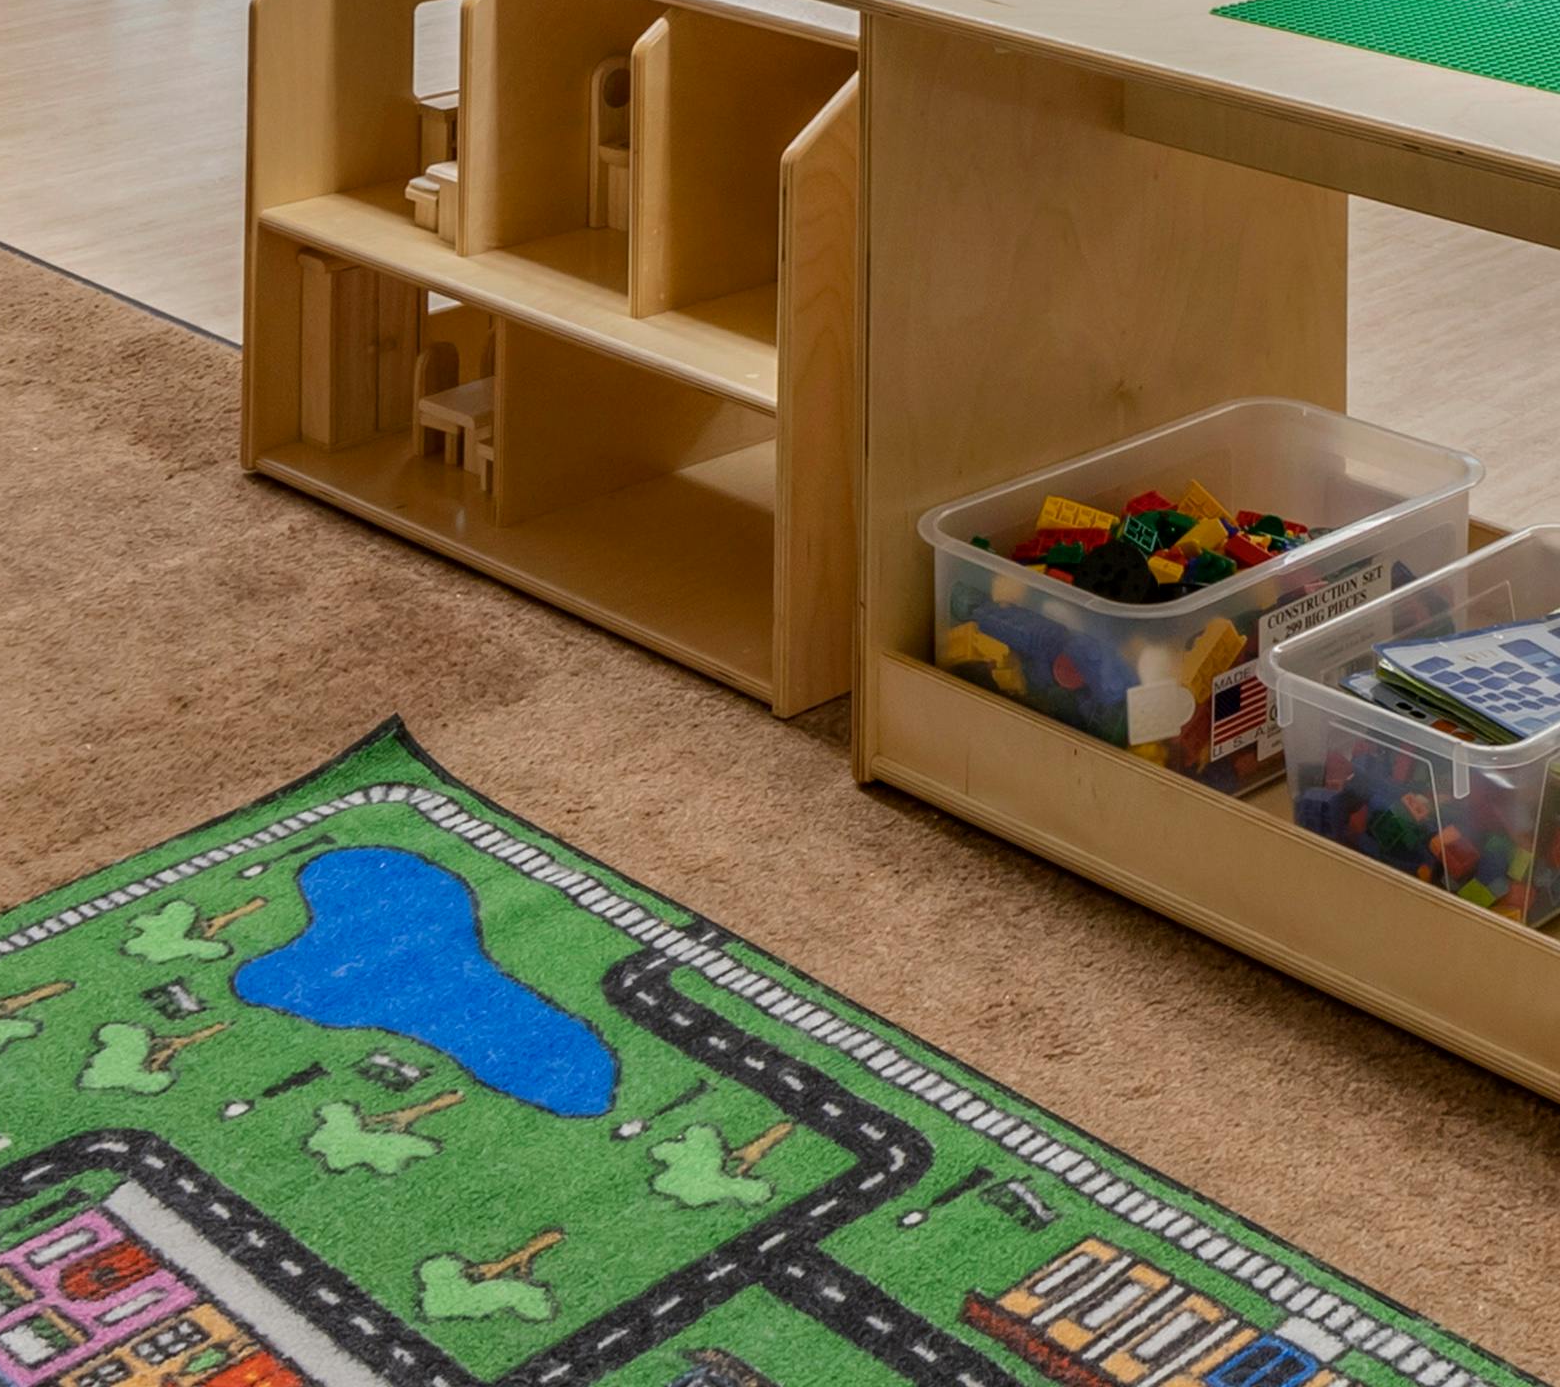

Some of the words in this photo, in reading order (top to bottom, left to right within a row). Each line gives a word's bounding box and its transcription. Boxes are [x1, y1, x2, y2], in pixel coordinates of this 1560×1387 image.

[1266, 577, 1358, 630] CONSTRUCTION
[1362, 564, 1384, 586] SET
[1284, 621, 1303, 639] 299
[1304, 611, 1325, 633] BIG
[1327, 589, 1368, 623] PIECES
[1214, 666, 1252, 690] MADE
